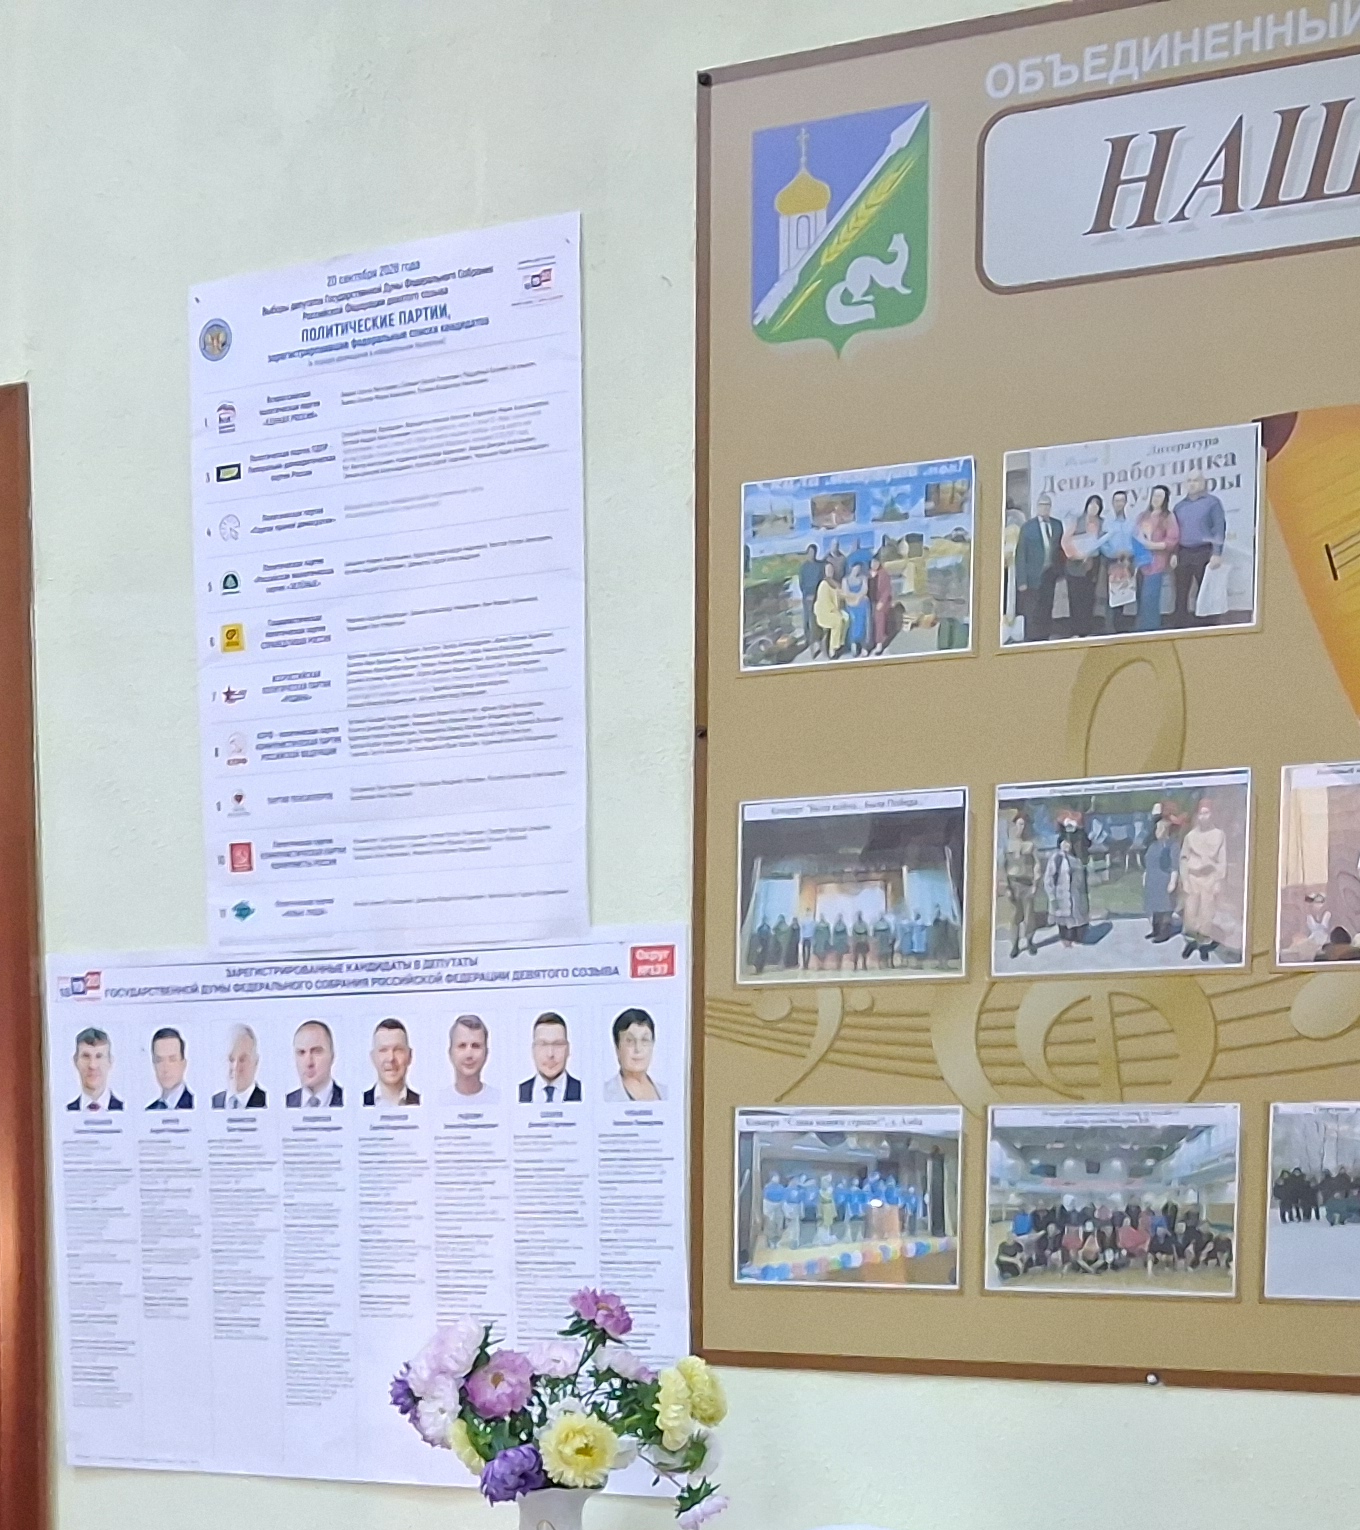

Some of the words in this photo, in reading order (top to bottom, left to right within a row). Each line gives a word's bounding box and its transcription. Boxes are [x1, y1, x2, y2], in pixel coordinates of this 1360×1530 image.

[301, 312, 395, 342] ПОЛИТИЧЕСКИЕ
[399, 303, 451, 325] ПАРТИИ,
[1041, 474, 1095, 495] День
[1102, 451, 1238, 491] работника
